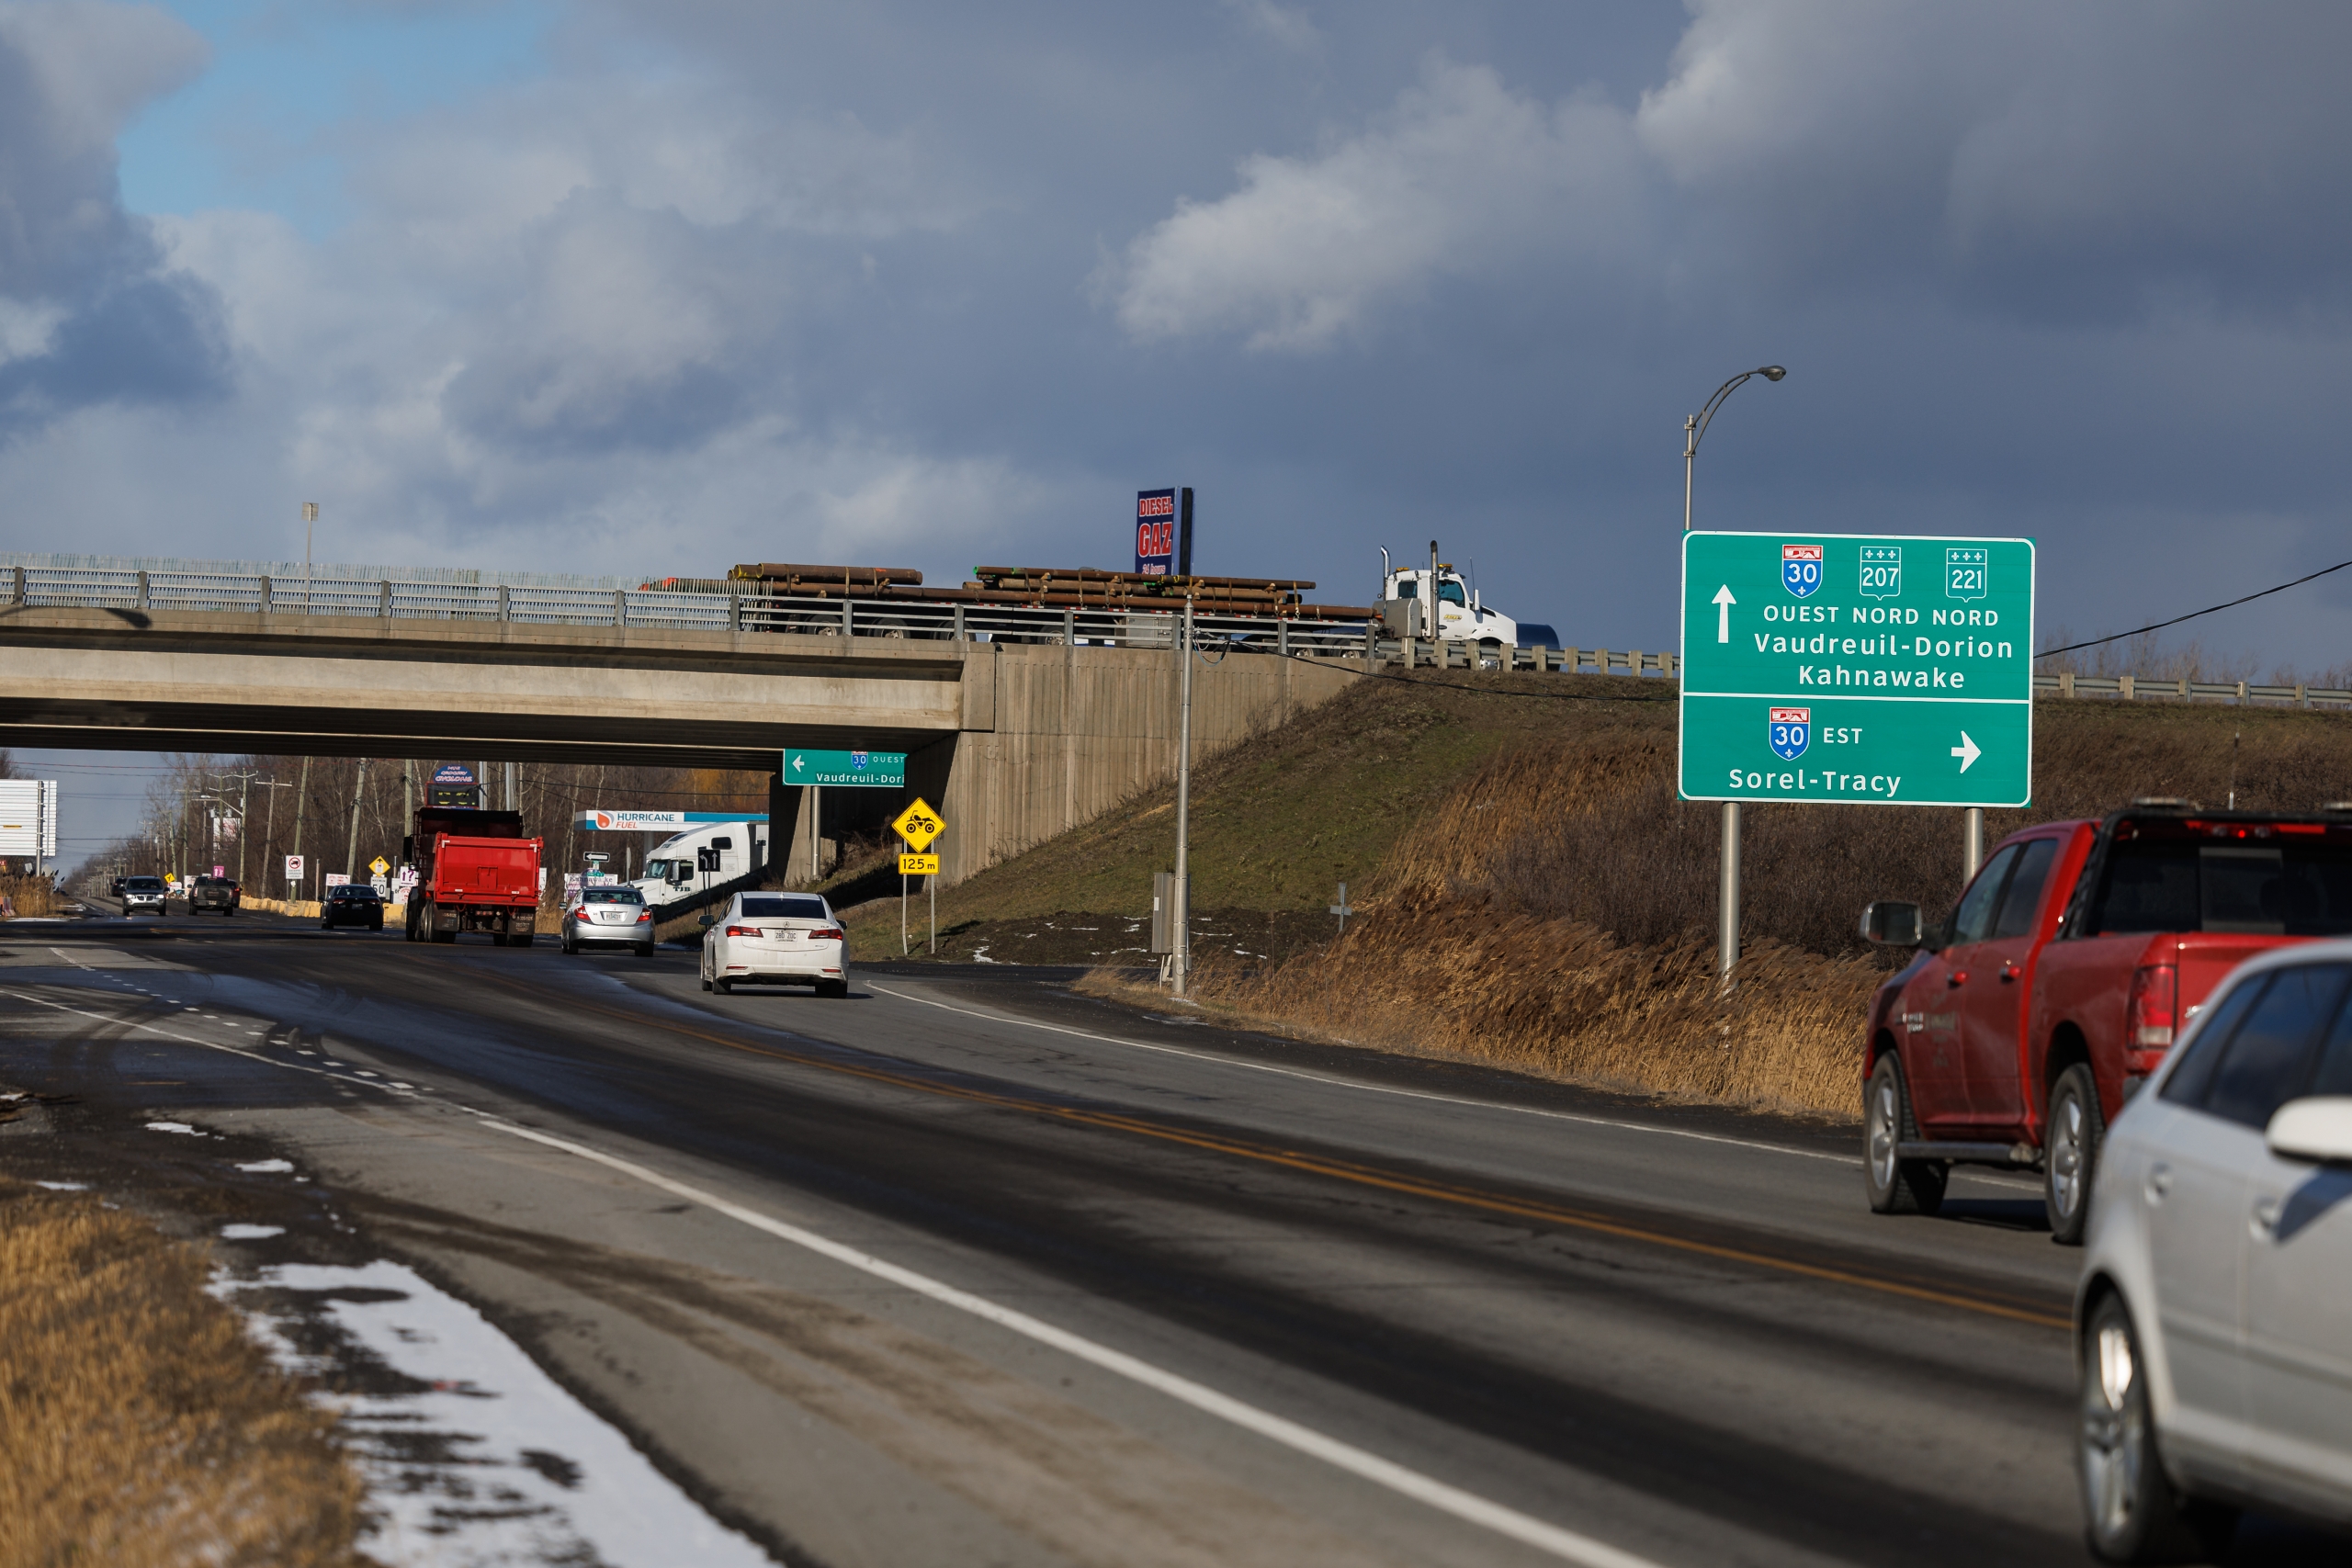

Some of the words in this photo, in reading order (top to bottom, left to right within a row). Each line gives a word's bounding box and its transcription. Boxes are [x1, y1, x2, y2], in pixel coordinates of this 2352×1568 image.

[1139, 496, 1173, 517] DIESEL
[1138, 522, 1172, 558] GAZ
[1787, 563, 1817, 584] 30
[1861, 567, 1899, 587] 207
[1951, 570, 1982, 590] 221
[1763, 604, 1839, 623] OUEST
[1852, 607, 1919, 625] NORD
[1932, 609, 1999, 626] NORD
[1754, 633, 2013, 659] Vaudreuil-Dorion
[1799, 665, 1965, 689] Kahnawake
[1774, 726, 1804, 747] 30
[1823, 728, 1862, 744] EST
[854, 756, 866, 764] 30
[1728, 769, 1902, 798] Sorel-Tracy
[617, 813, 674, 822] HURRICANE
[903, 859, 925, 870] 125
[372, 884, 385, 895] 50
